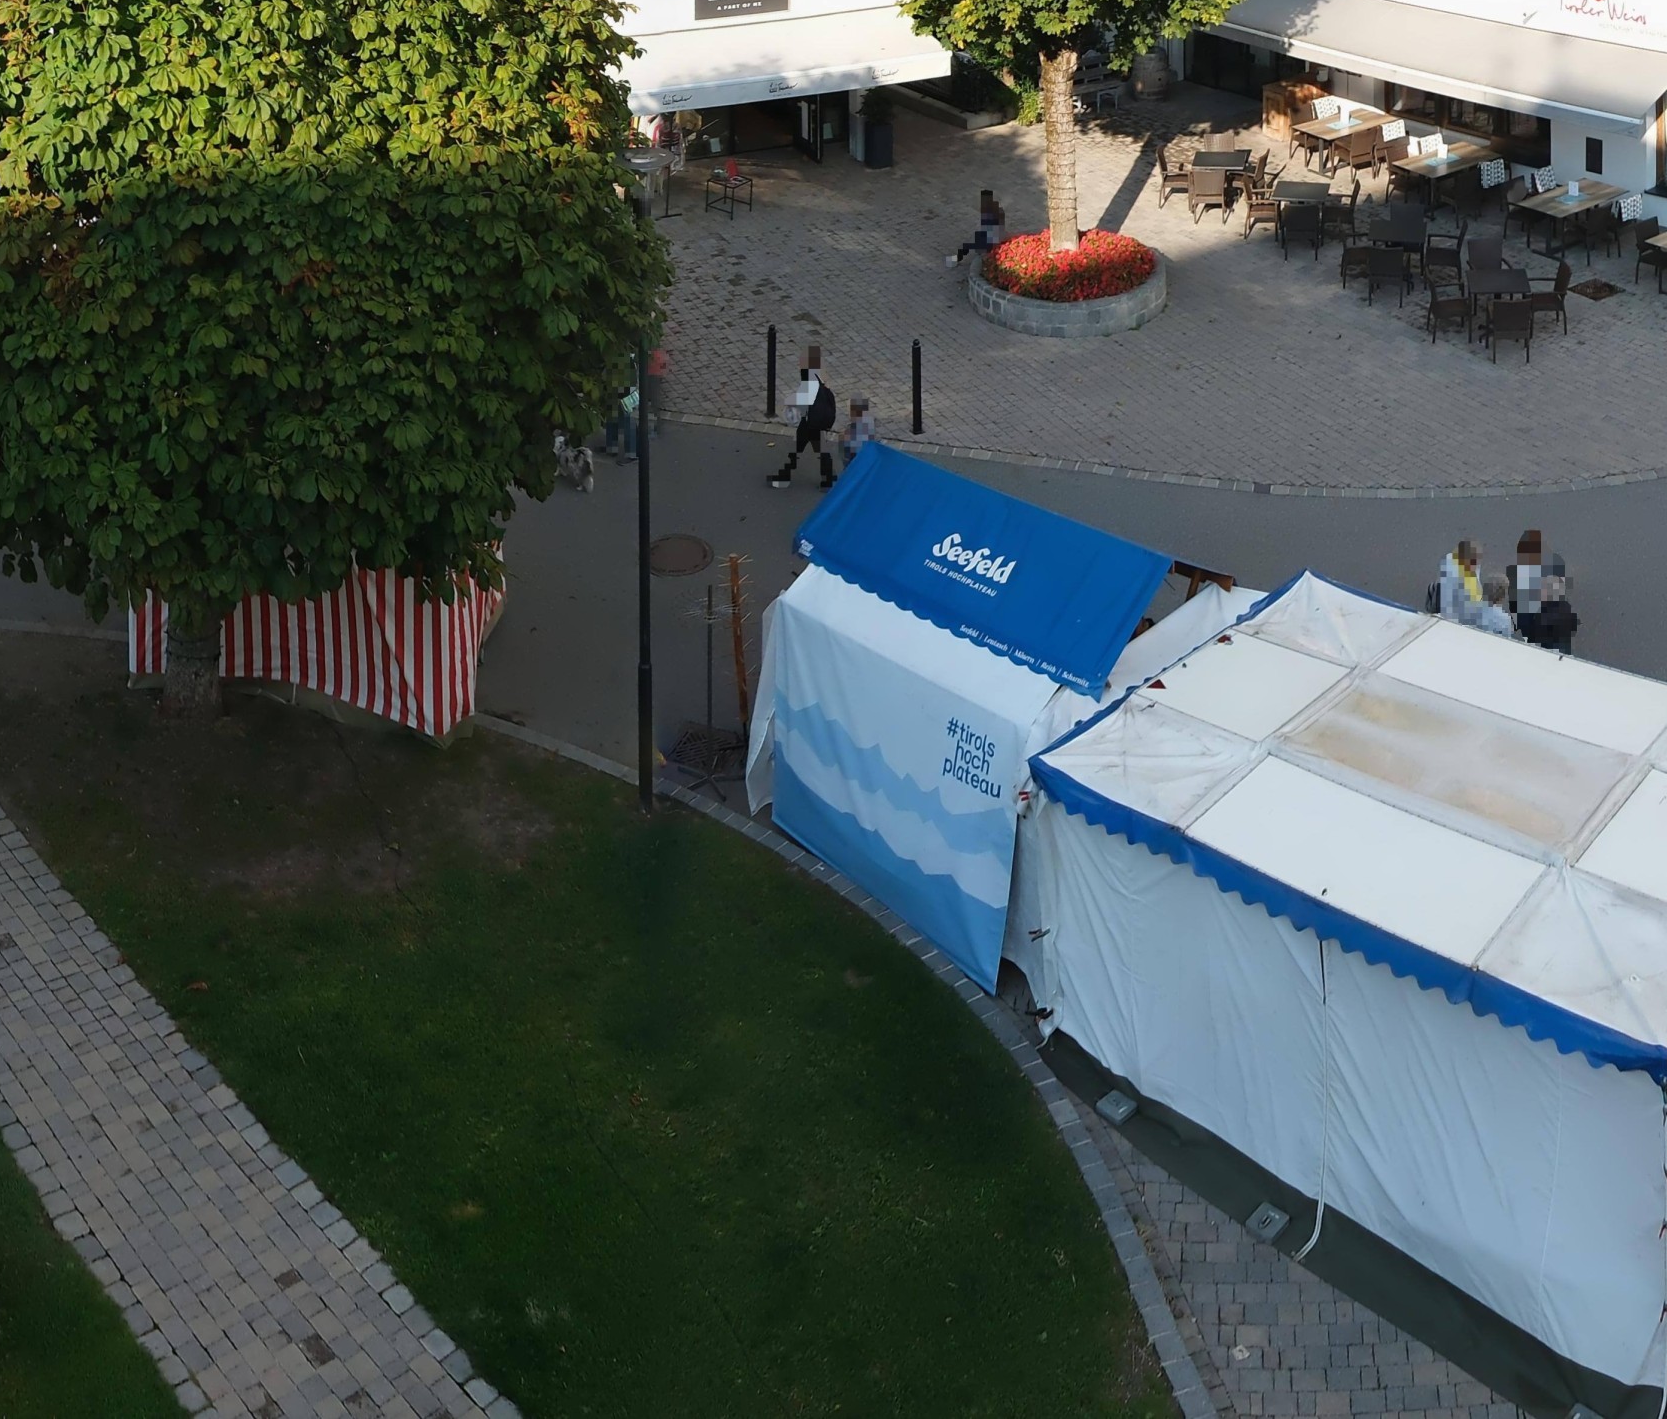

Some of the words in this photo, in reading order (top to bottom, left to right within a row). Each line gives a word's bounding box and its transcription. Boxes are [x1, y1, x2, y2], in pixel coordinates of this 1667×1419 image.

[924, 558, 948, 575] TIROLS
[948, 570, 998, 597] HOCHPLATEAU
[932, 533, 1017, 584] Seefeld
[946, 717, 996, 757] #tirols
[943, 756, 1002, 798] plateau
[955, 739, 990, 776] hoch
